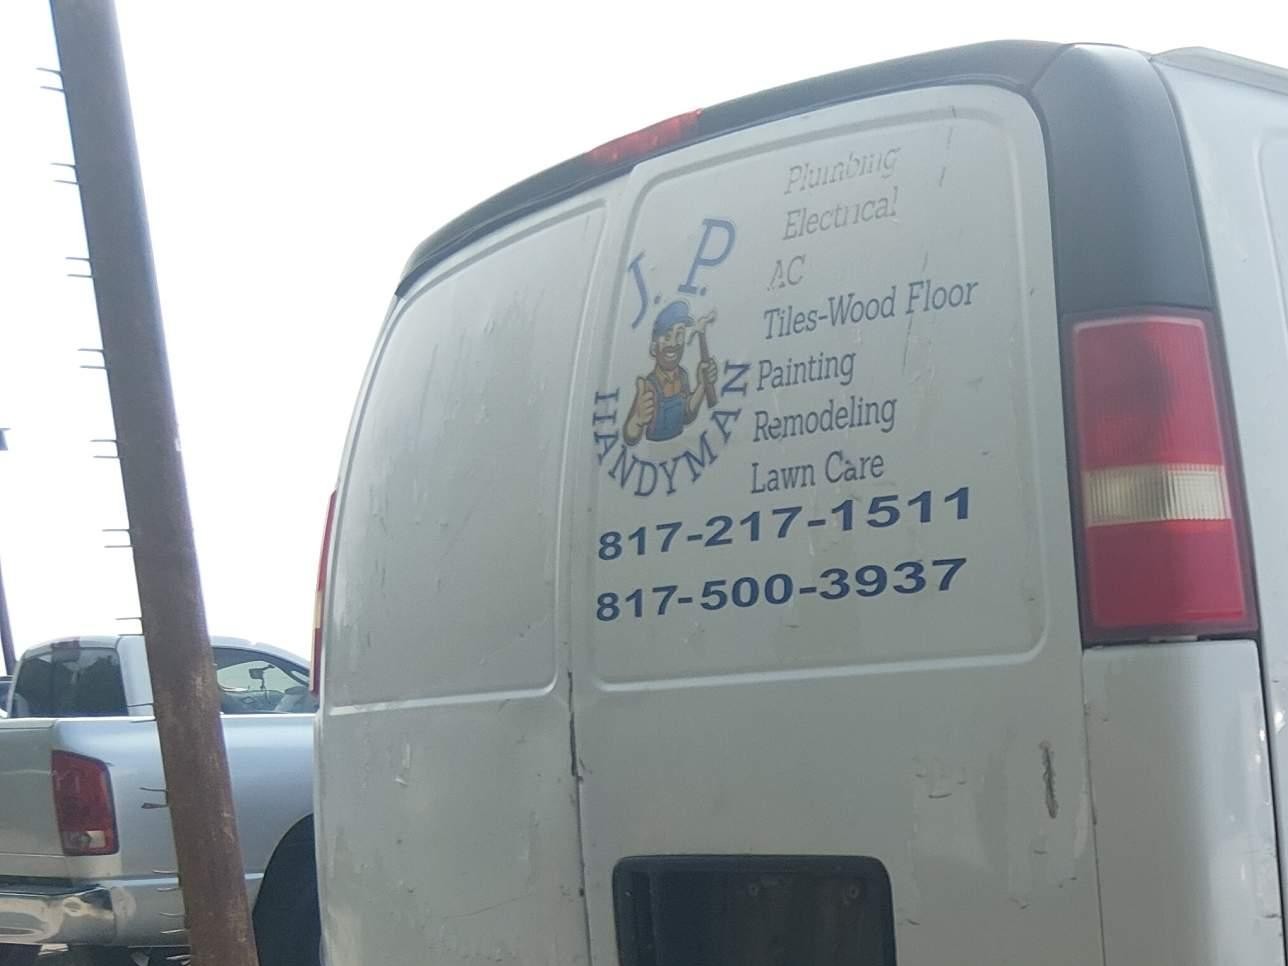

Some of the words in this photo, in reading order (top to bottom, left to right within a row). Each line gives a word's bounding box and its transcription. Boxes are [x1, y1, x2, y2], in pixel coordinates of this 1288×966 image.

[782, 185, 899, 240] Electrical
[767, 254, 806, 292] AC
[763, 285, 897, 340] Tiles-Wood
[905, 279, 979, 315] Floor
[756, 352, 856, 391] Painting
[752, 395, 898, 442] Remodeling
[751, 462, 816, 494] Lawn
[824, 449, 884, 484] Care
[598, 487, 969, 561] 817-217-1511
[596, 558, 967, 622] 817-500-3937
